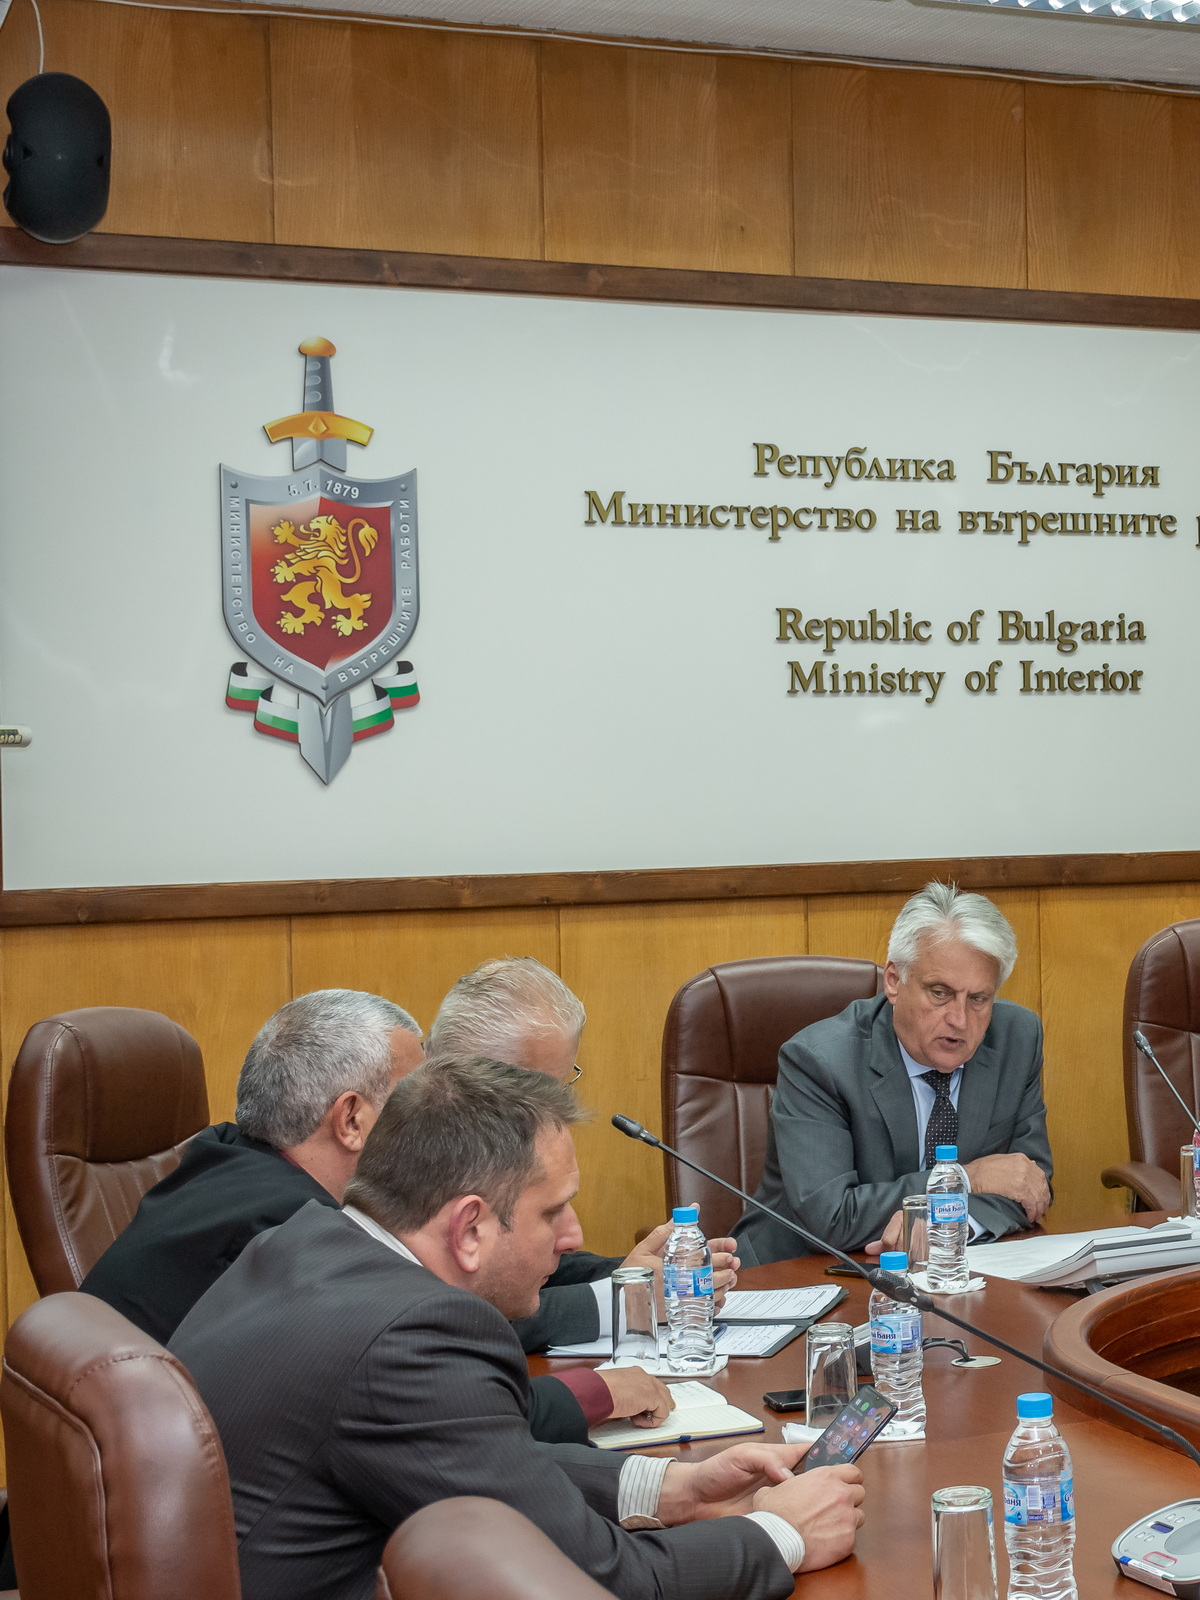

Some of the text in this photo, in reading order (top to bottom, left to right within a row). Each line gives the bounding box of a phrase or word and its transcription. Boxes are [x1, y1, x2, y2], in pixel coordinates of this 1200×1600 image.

[326, 479, 359, 499] 1879
[753, 442, 1160, 497] Република България
[584, 491, 876, 542] Министерство
[896, 510, 941, 532] на
[958, 504, 1177, 545] вътрешните
[230, 496, 412, 683] МИНИСТЕРСТВО НА ВЪТРЕШНИТЕ РАБОТИ
[776, 608, 1146, 654] Republic of Bulgaria
[787, 659, 1143, 704] Ministry of Interior
